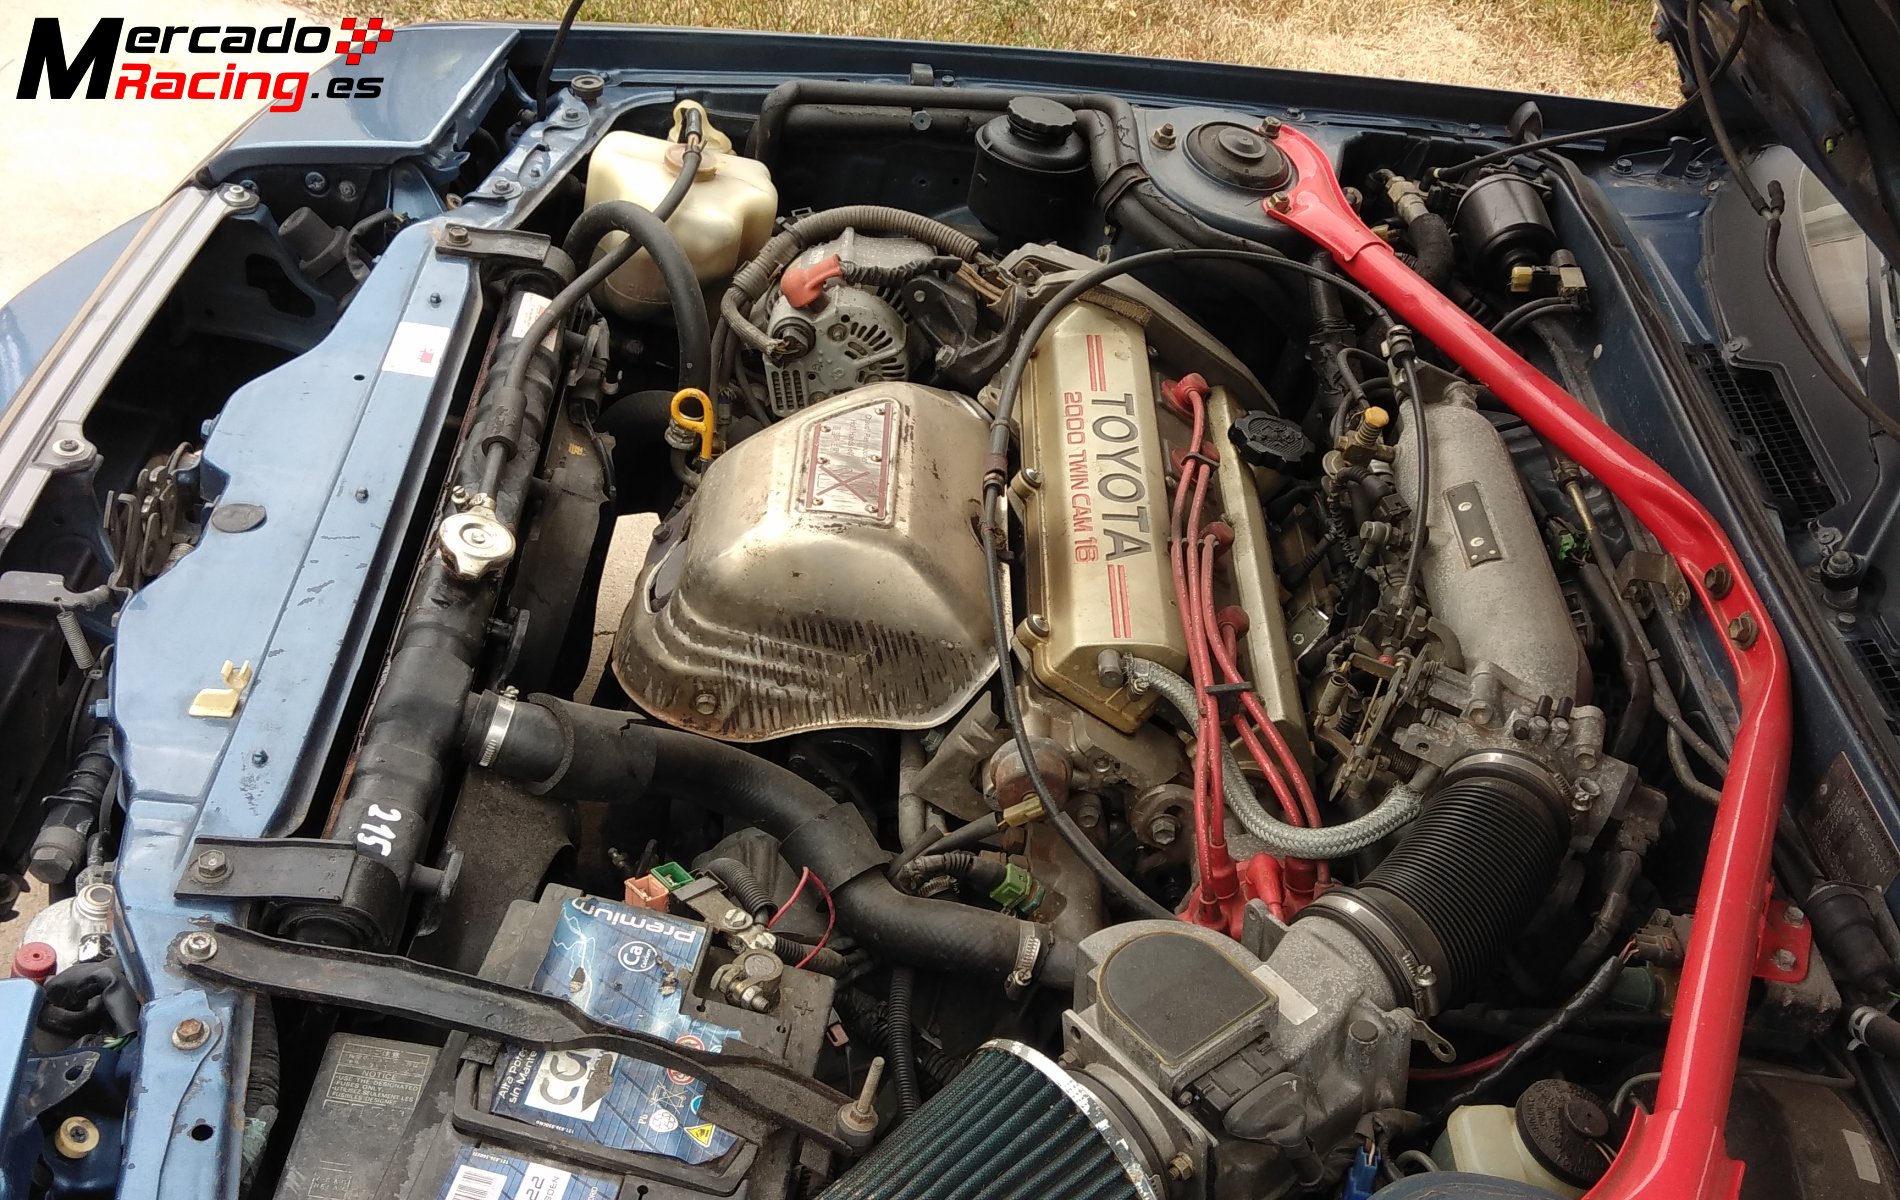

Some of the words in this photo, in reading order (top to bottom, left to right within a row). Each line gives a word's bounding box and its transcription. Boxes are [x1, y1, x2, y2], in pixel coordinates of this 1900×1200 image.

[1063, 391, 1085, 445] 2000
[1068, 449, 1090, 491] TWIN
[1092, 393, 1151, 561] TOYOTA
[1070, 493, 1094, 532] CAM
[1074, 537, 1099, 563] 16
[357, 804, 402, 857] 215
[571, 897, 697, 943] Premium
[623, 945, 644, 966] Ca
[361, 1069, 399, 1081] NOTICE
[373, 1080, 419, 1092] DESIGNATED
[498, 1076, 514, 1099] Alta
[509, 1086, 522, 1104] sin
